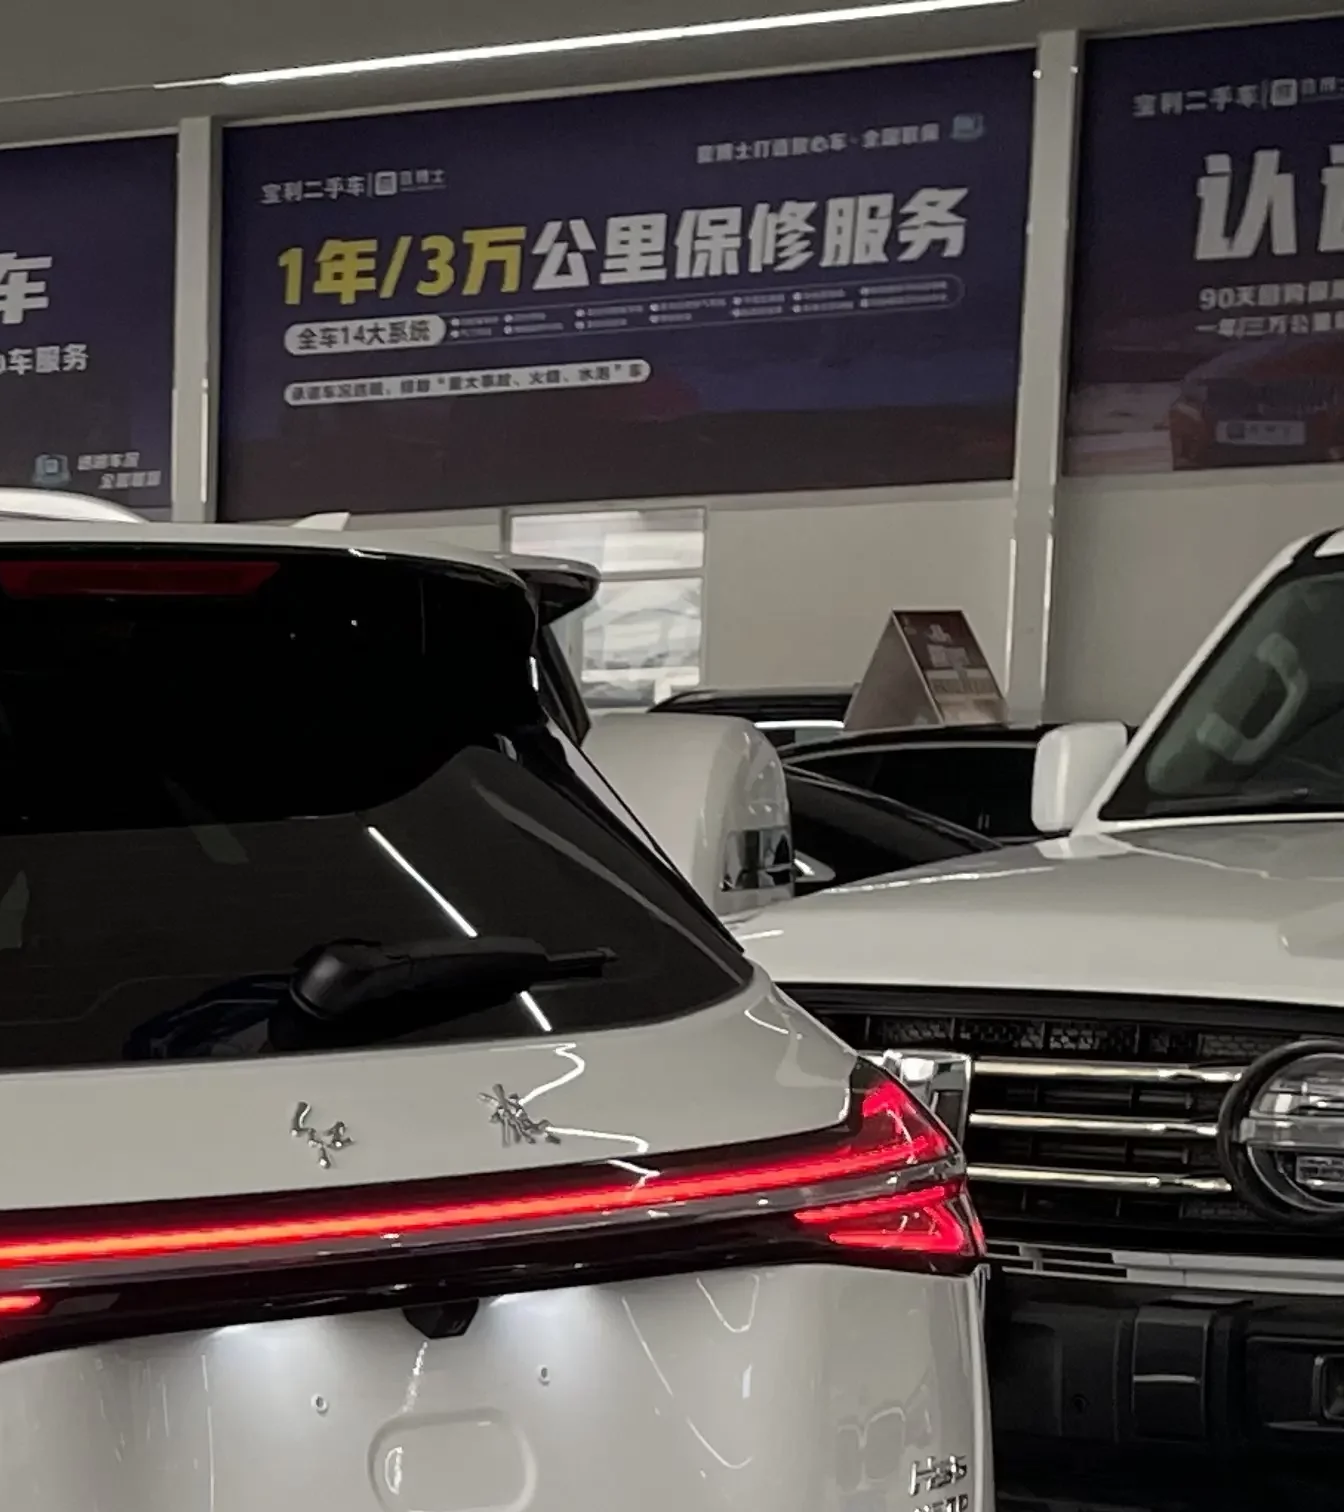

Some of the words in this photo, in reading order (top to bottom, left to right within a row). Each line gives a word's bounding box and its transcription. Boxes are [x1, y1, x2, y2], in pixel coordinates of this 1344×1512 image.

[278, 187, 968, 304] 1年/3万公里保修服务
[296, 319, 432, 350] 全车14大系统
